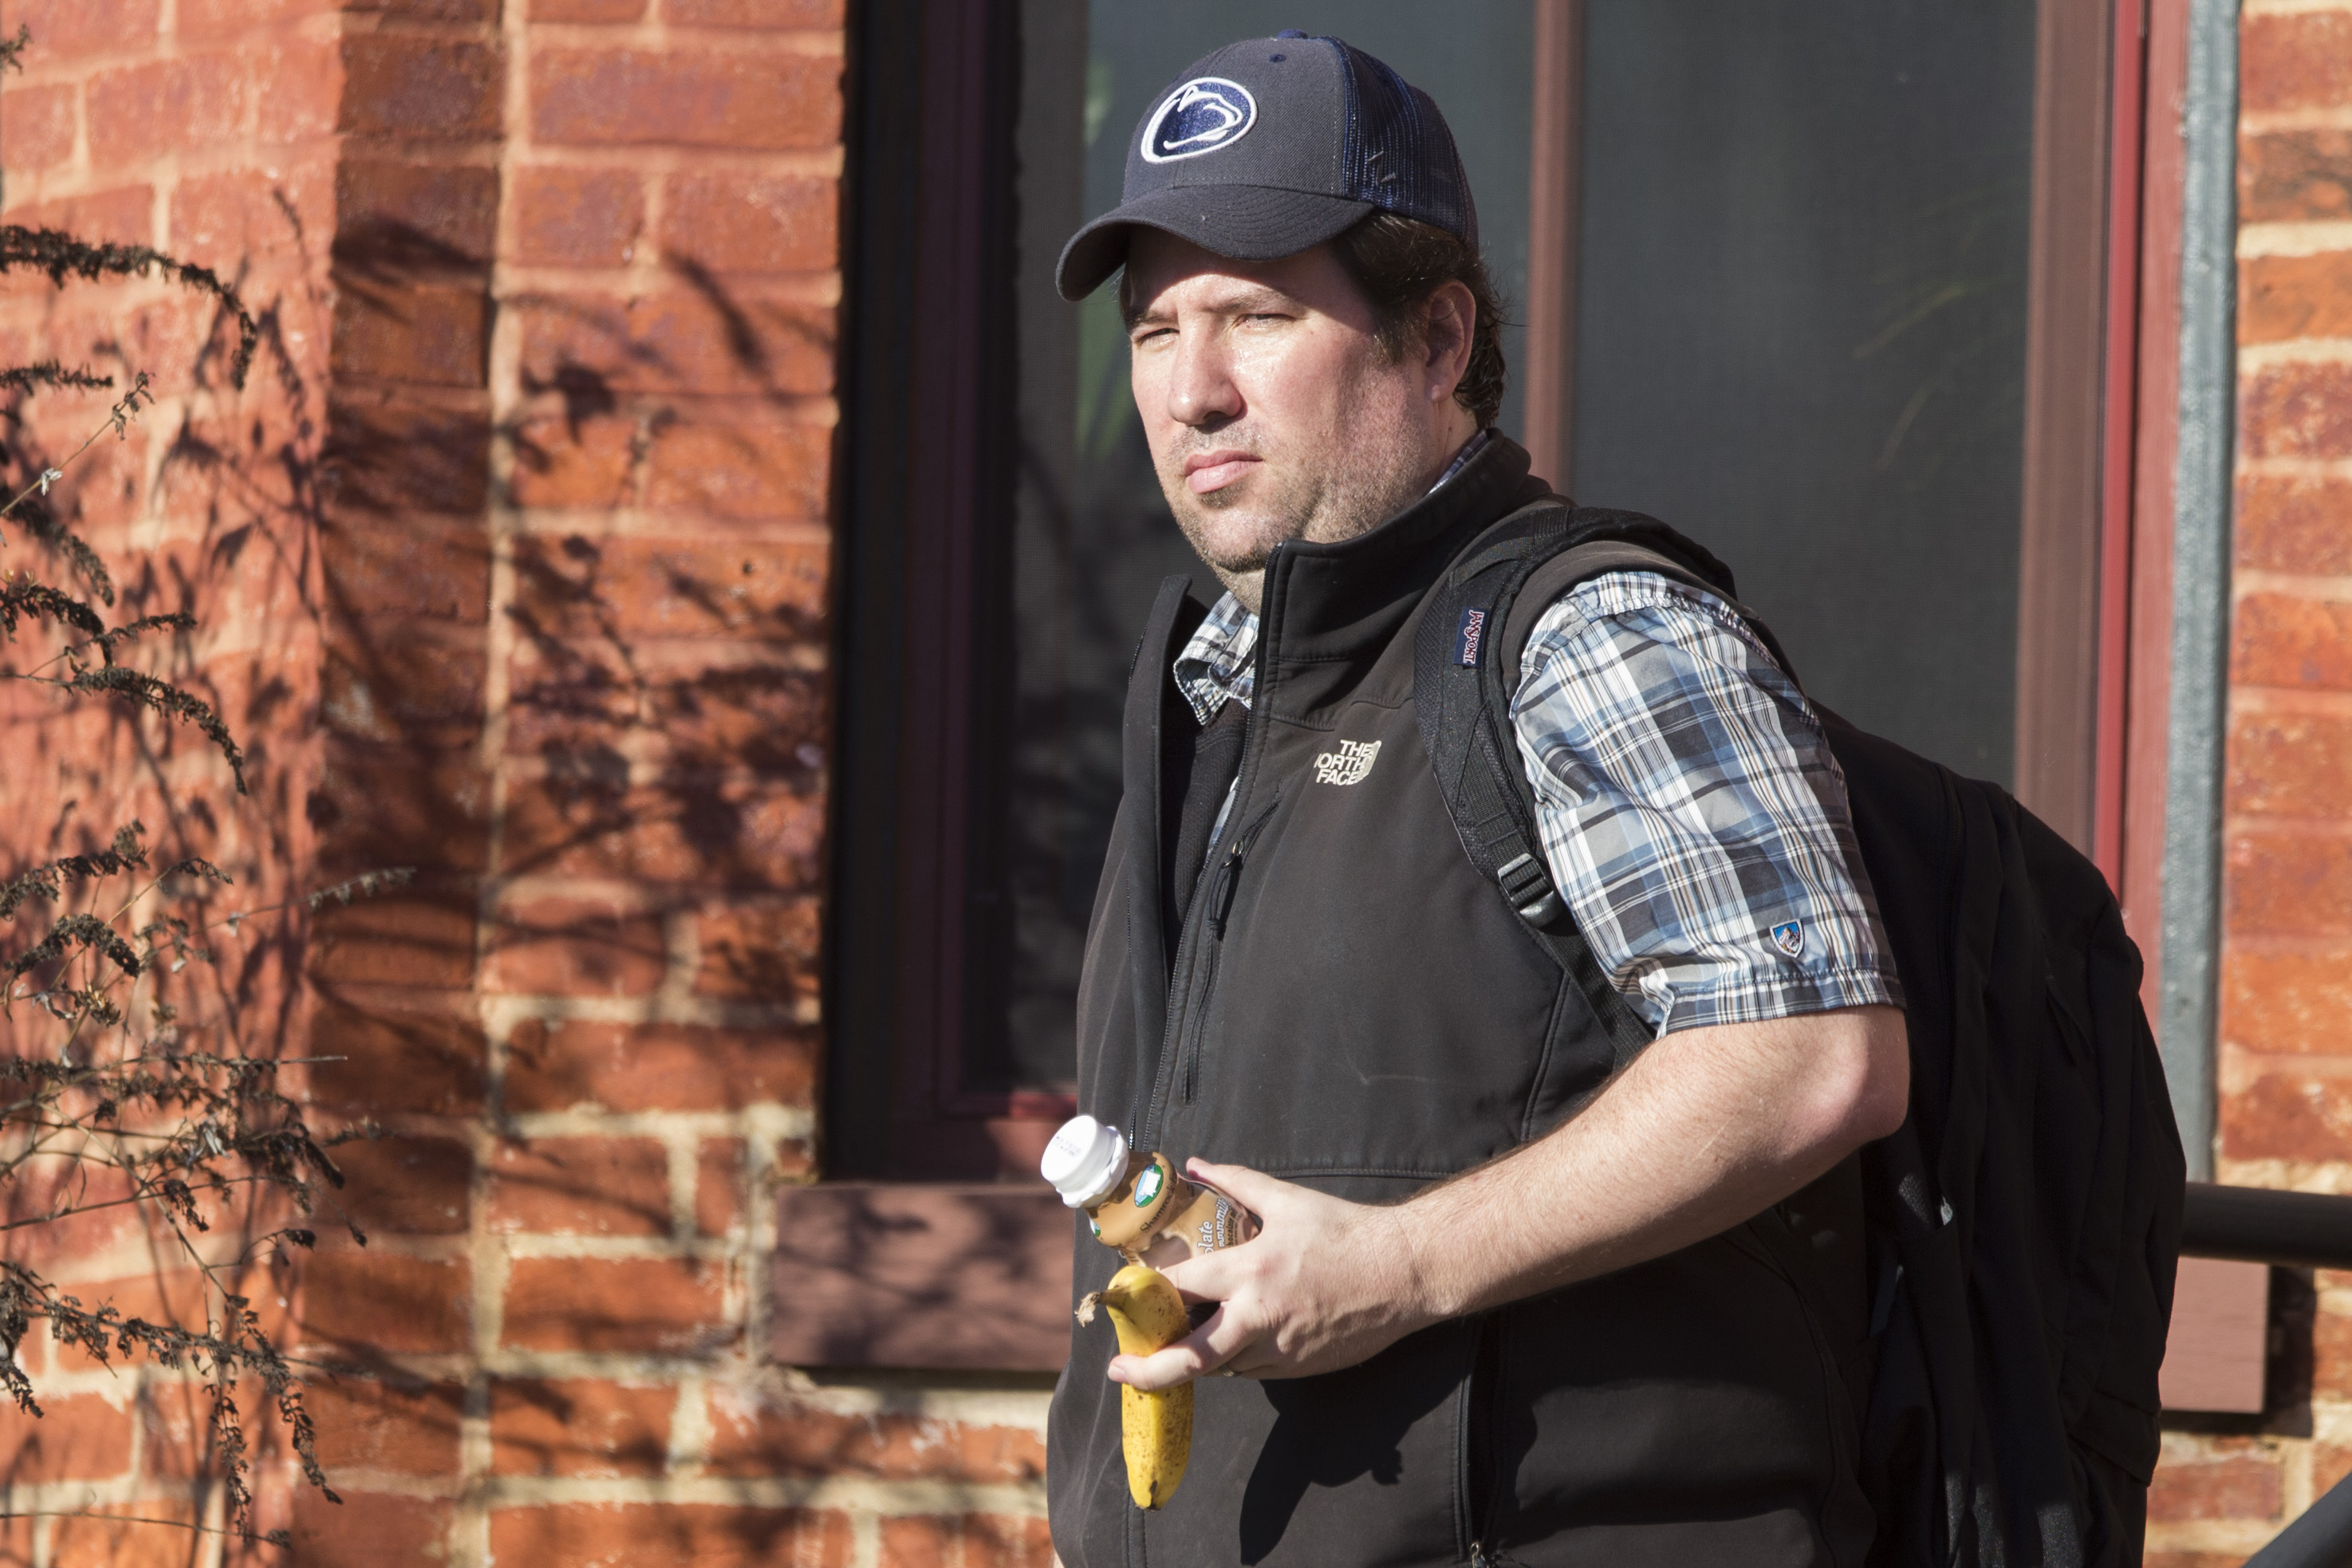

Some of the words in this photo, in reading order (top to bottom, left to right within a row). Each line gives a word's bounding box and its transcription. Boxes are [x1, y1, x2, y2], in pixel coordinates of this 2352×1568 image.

[1340, 739, 1374, 757] THE
[1316, 769, 1359, 786] FACE
[1141, 1186, 1175, 1231] Shamrock
